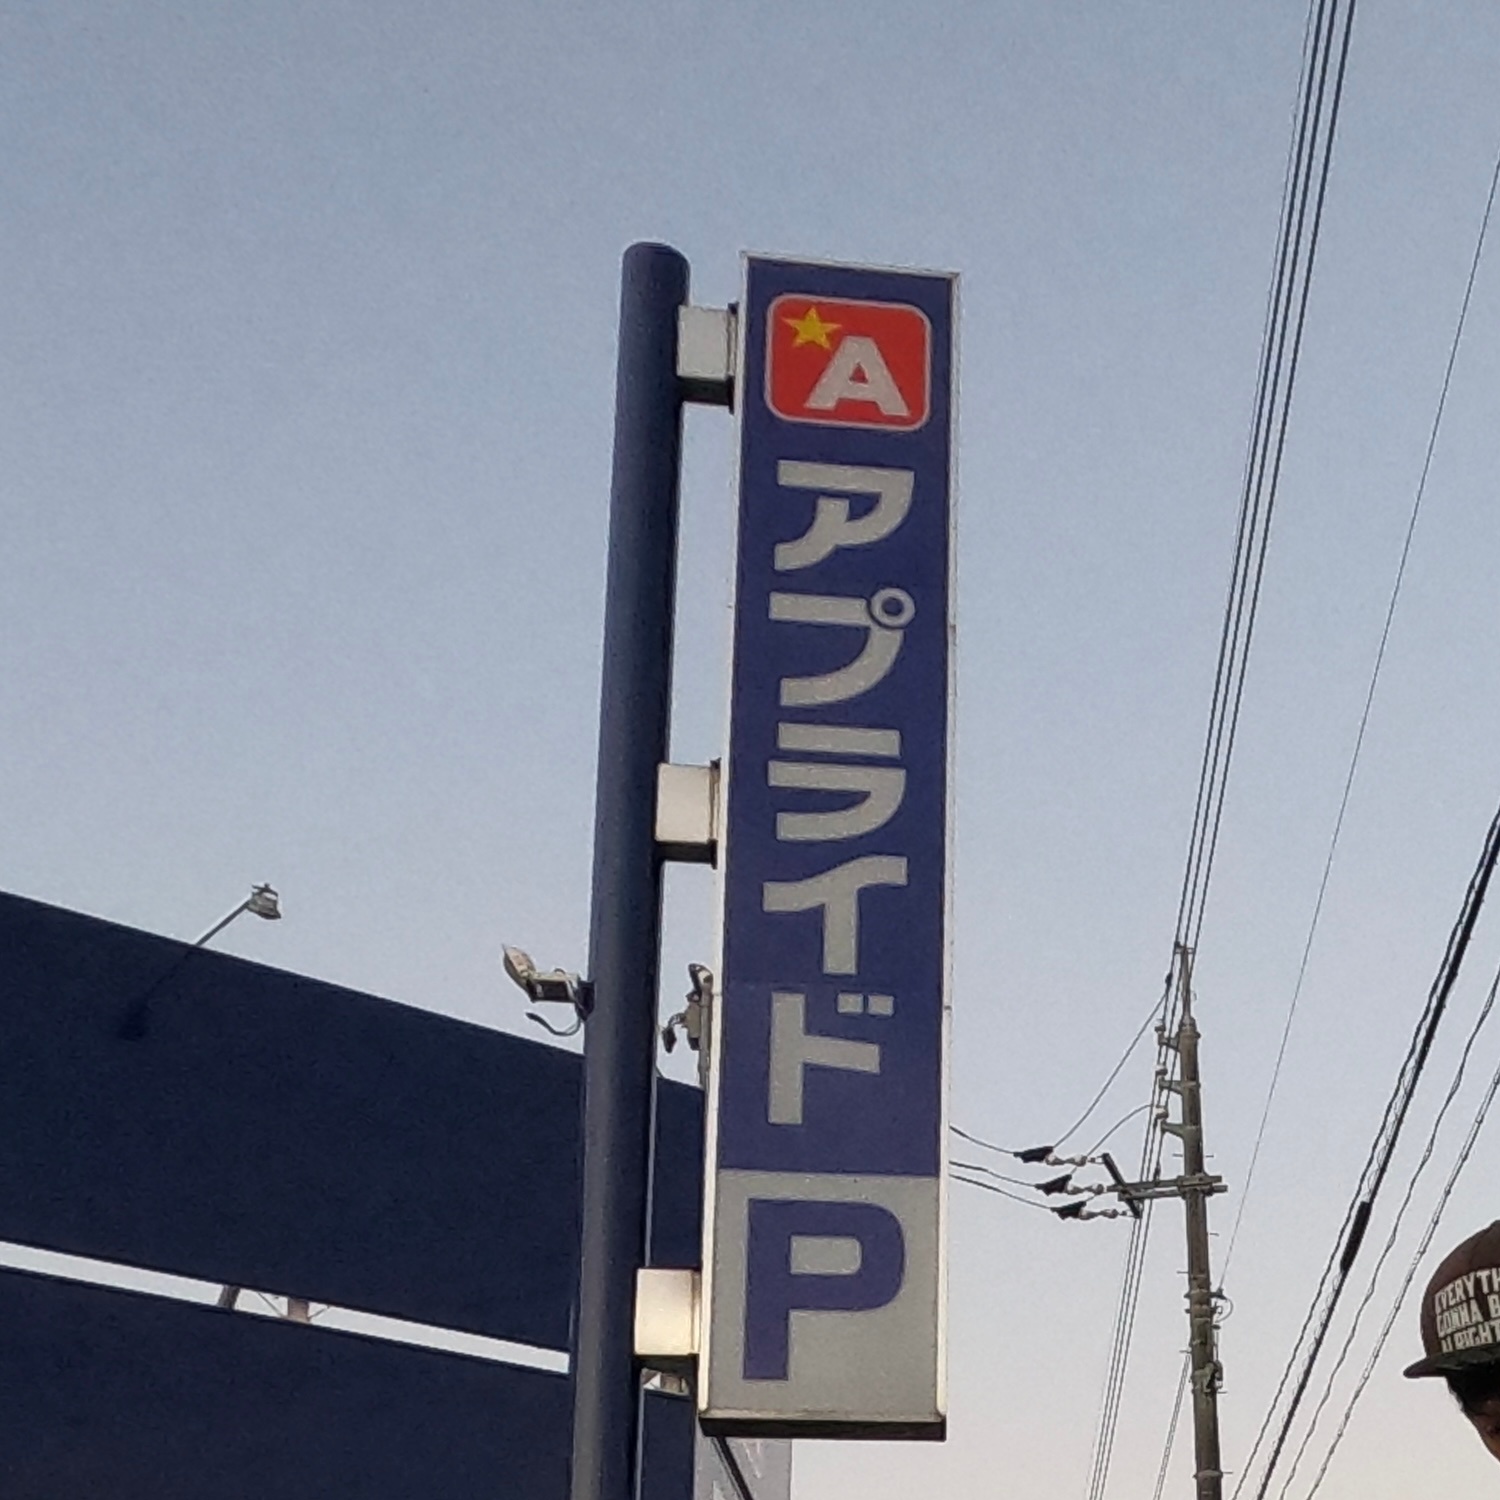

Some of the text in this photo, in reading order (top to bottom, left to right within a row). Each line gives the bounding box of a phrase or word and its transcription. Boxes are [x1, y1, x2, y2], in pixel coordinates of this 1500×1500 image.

[804, 334, 910, 417] A
[762, 459, 916, 1127] アプライド
[742, 1197, 906, 1382] P
